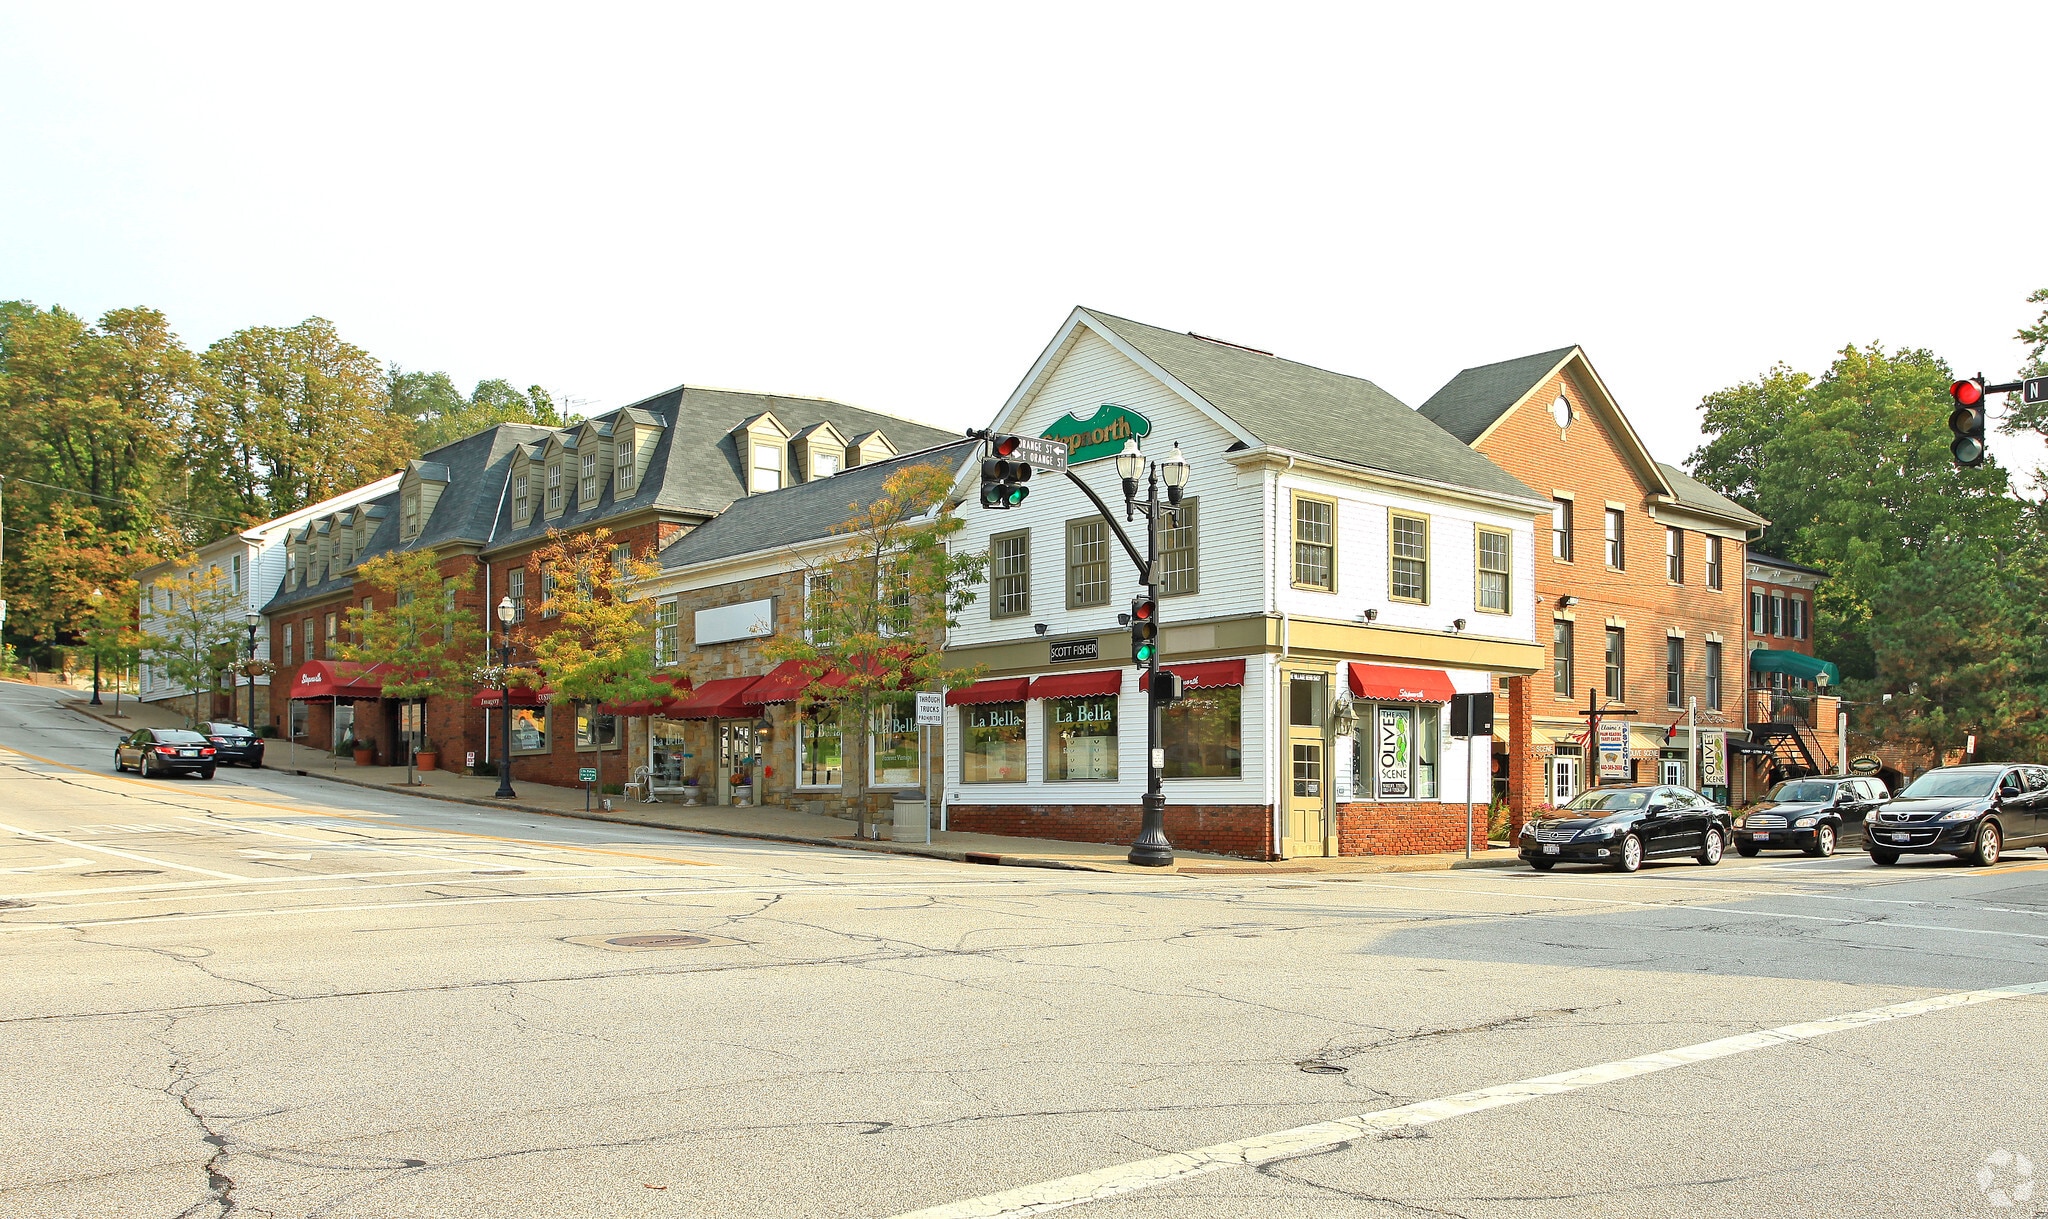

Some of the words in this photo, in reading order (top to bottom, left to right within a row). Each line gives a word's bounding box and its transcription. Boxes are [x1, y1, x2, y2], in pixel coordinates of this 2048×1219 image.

[2030, 382, 2039, 399] N
[1041, 415, 1131, 455] epnorth
[1018, 438, 1042, 452] ORANGE
[1045, 444, 1053, 454] ST
[1022, 450, 1027, 461] E
[1029, 452, 1054, 466] ORANGE
[1056, 458, 1064, 468] ST
[1051, 646, 1072, 658] SCOTT
[1073, 643, 1097, 656] FISHER
[919, 695, 941, 704] THROUGH
[920, 705, 940, 713] TRUCKS
[1056, 706, 1073, 723] La
[1077, 704, 1112, 722] Bella
[875, 719, 890, 734] La
[893, 717, 919, 733] Bella
[970, 712, 985, 728] La
[989, 710, 1021, 727] Bella
[803, 724, 815, 739] La
[1381, 718, 1395, 768] OLIVE
[1536, 745, 1553, 753] SCENE
[1643, 749, 1659, 757] SCENE
[1704, 739, 1714, 775] OLIVE
[1382, 768, 1407, 779] SCENE
[1705, 775, 1725, 783] SCENE
